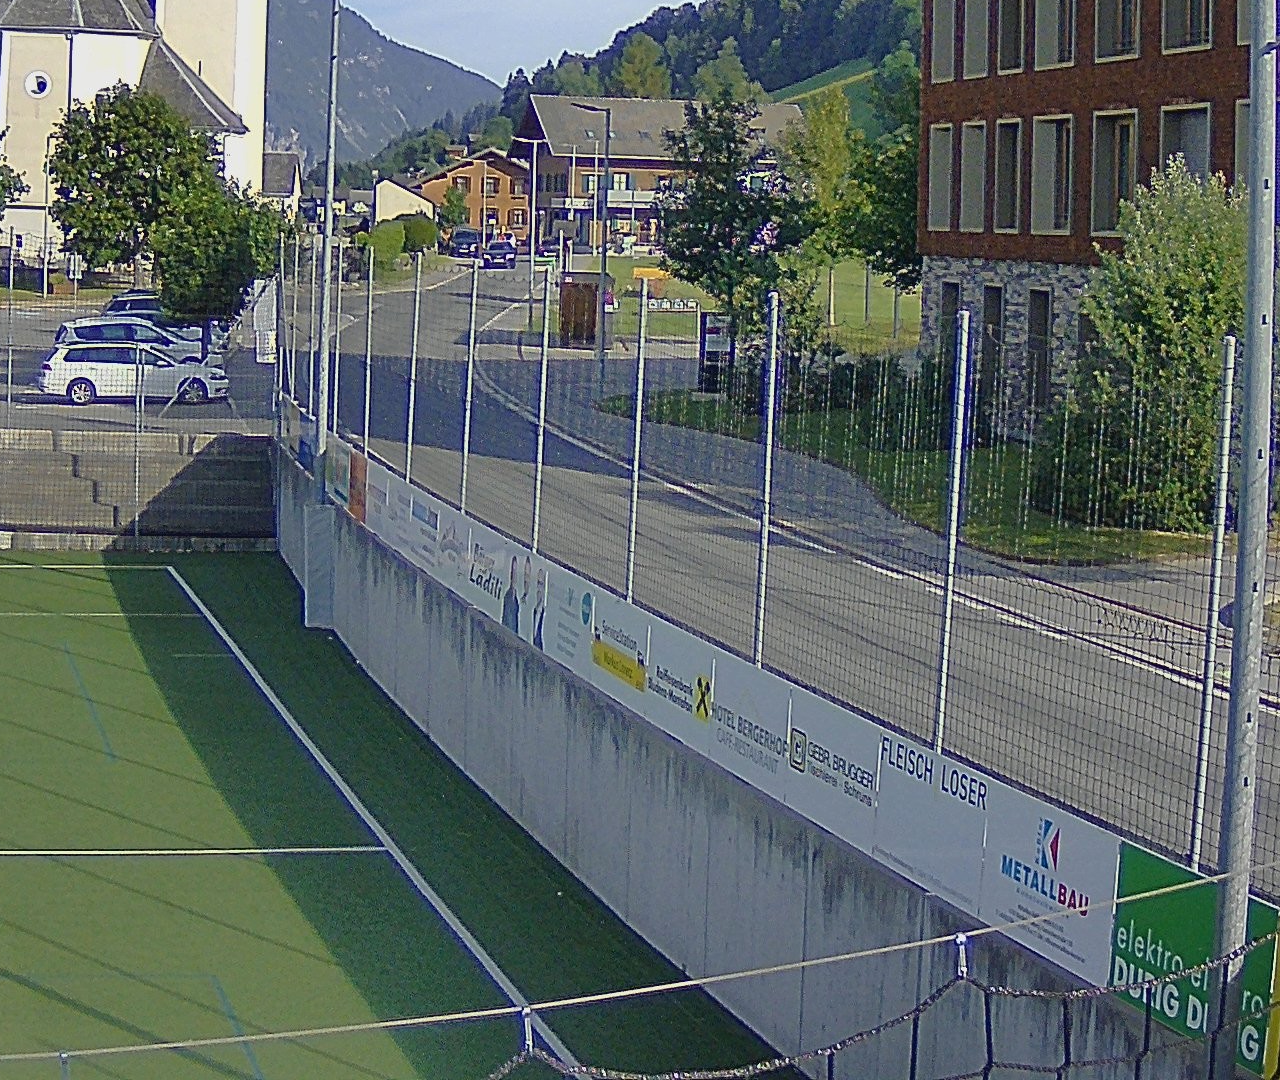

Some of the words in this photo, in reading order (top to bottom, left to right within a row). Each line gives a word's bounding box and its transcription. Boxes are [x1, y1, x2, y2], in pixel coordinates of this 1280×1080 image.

[711, 702, 736, 730] HOTEL
[881, 735, 934, 785] FLEISCH
[940, 764, 988, 811] LOSER
[1001, 854, 1090, 917] METALLBAU
[1117, 919, 1183, 974] elektro
[1190, 956, 1264, 1019] elro
